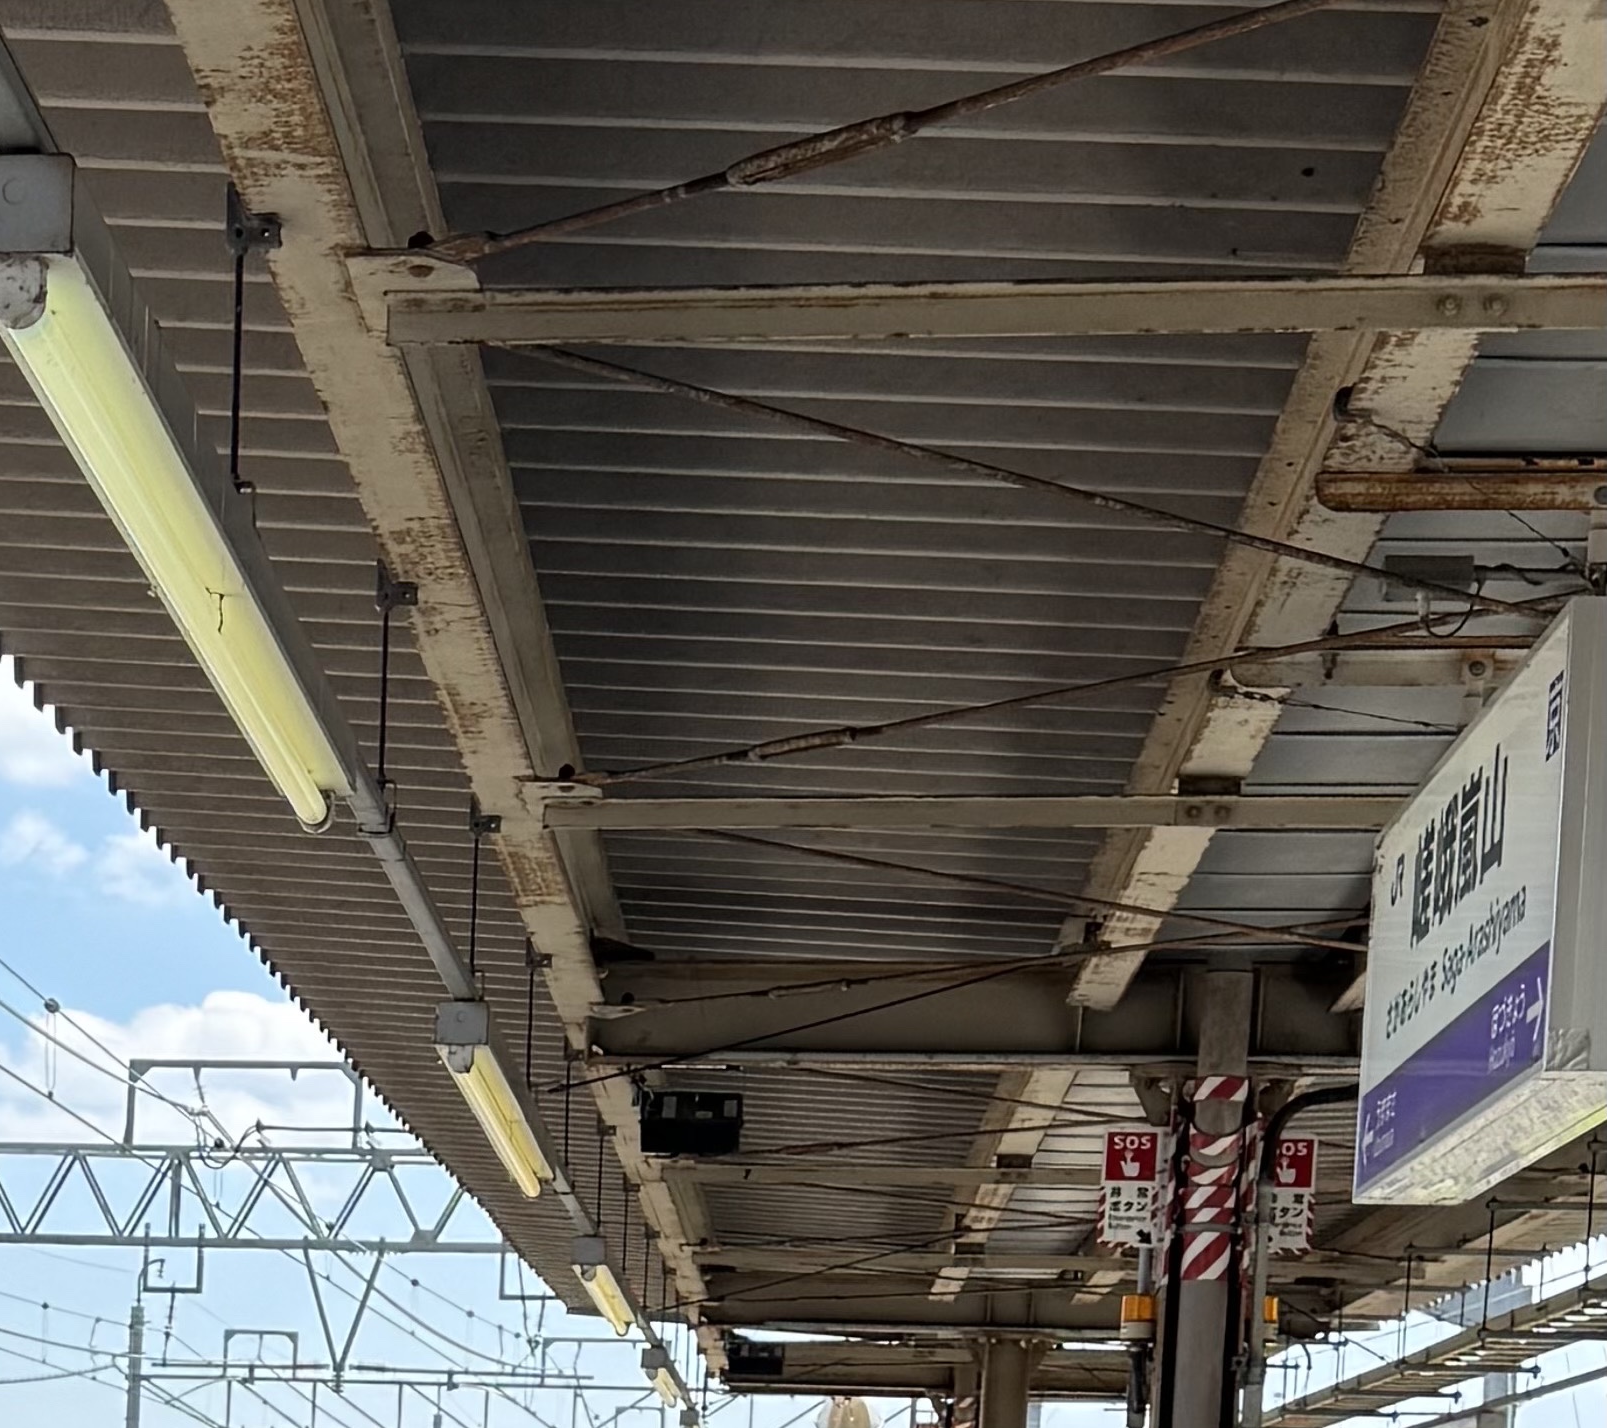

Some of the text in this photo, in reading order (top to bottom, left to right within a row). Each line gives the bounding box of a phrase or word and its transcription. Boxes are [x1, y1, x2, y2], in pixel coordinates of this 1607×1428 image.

[1410, 742, 1508, 949] 嵯峨嵐山
[1390, 852, 1406, 907] JR
[1113, 1135, 1151, 1150] SOS
[1276, 1142, 1308, 1157] OS
